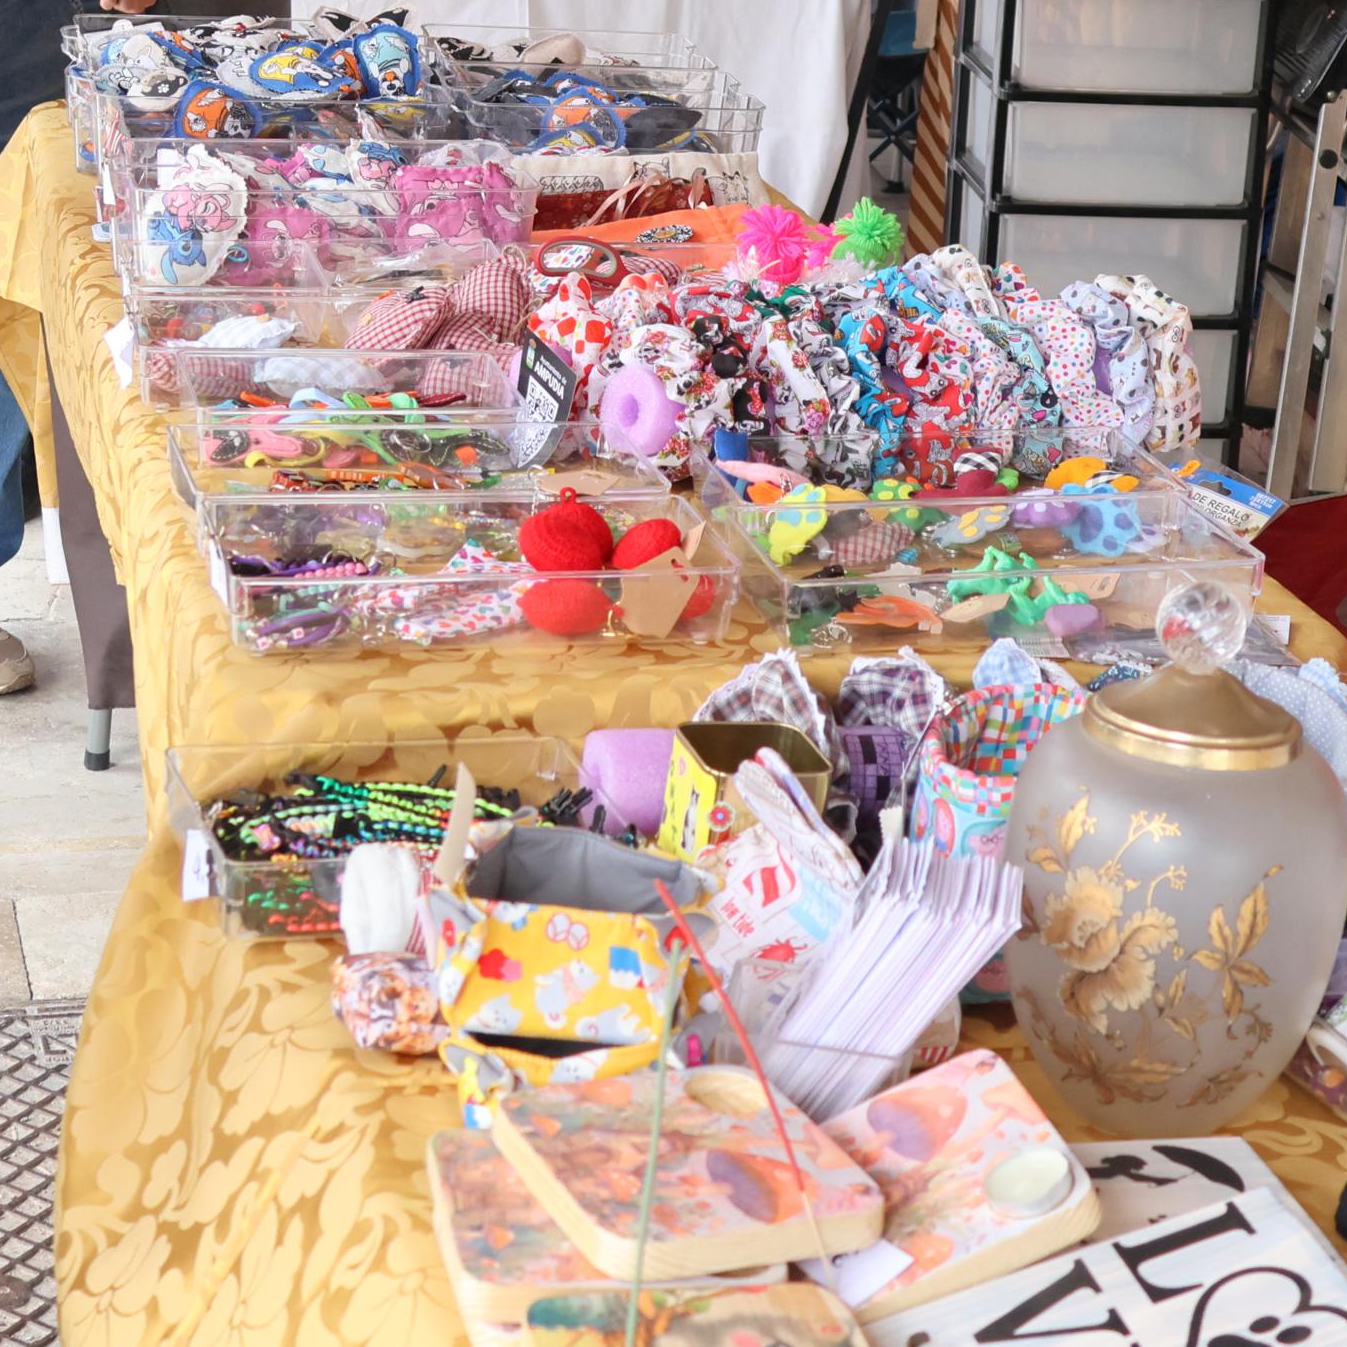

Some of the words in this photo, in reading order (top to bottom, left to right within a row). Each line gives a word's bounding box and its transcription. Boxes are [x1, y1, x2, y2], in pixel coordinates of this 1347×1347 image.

[534, 360, 564, 400] AMPUDIA
[1192, 492, 1208, 504] DE
[1208, 499, 1250, 522] REGALO
[1204, 507, 1242, 528] ORGANZA
